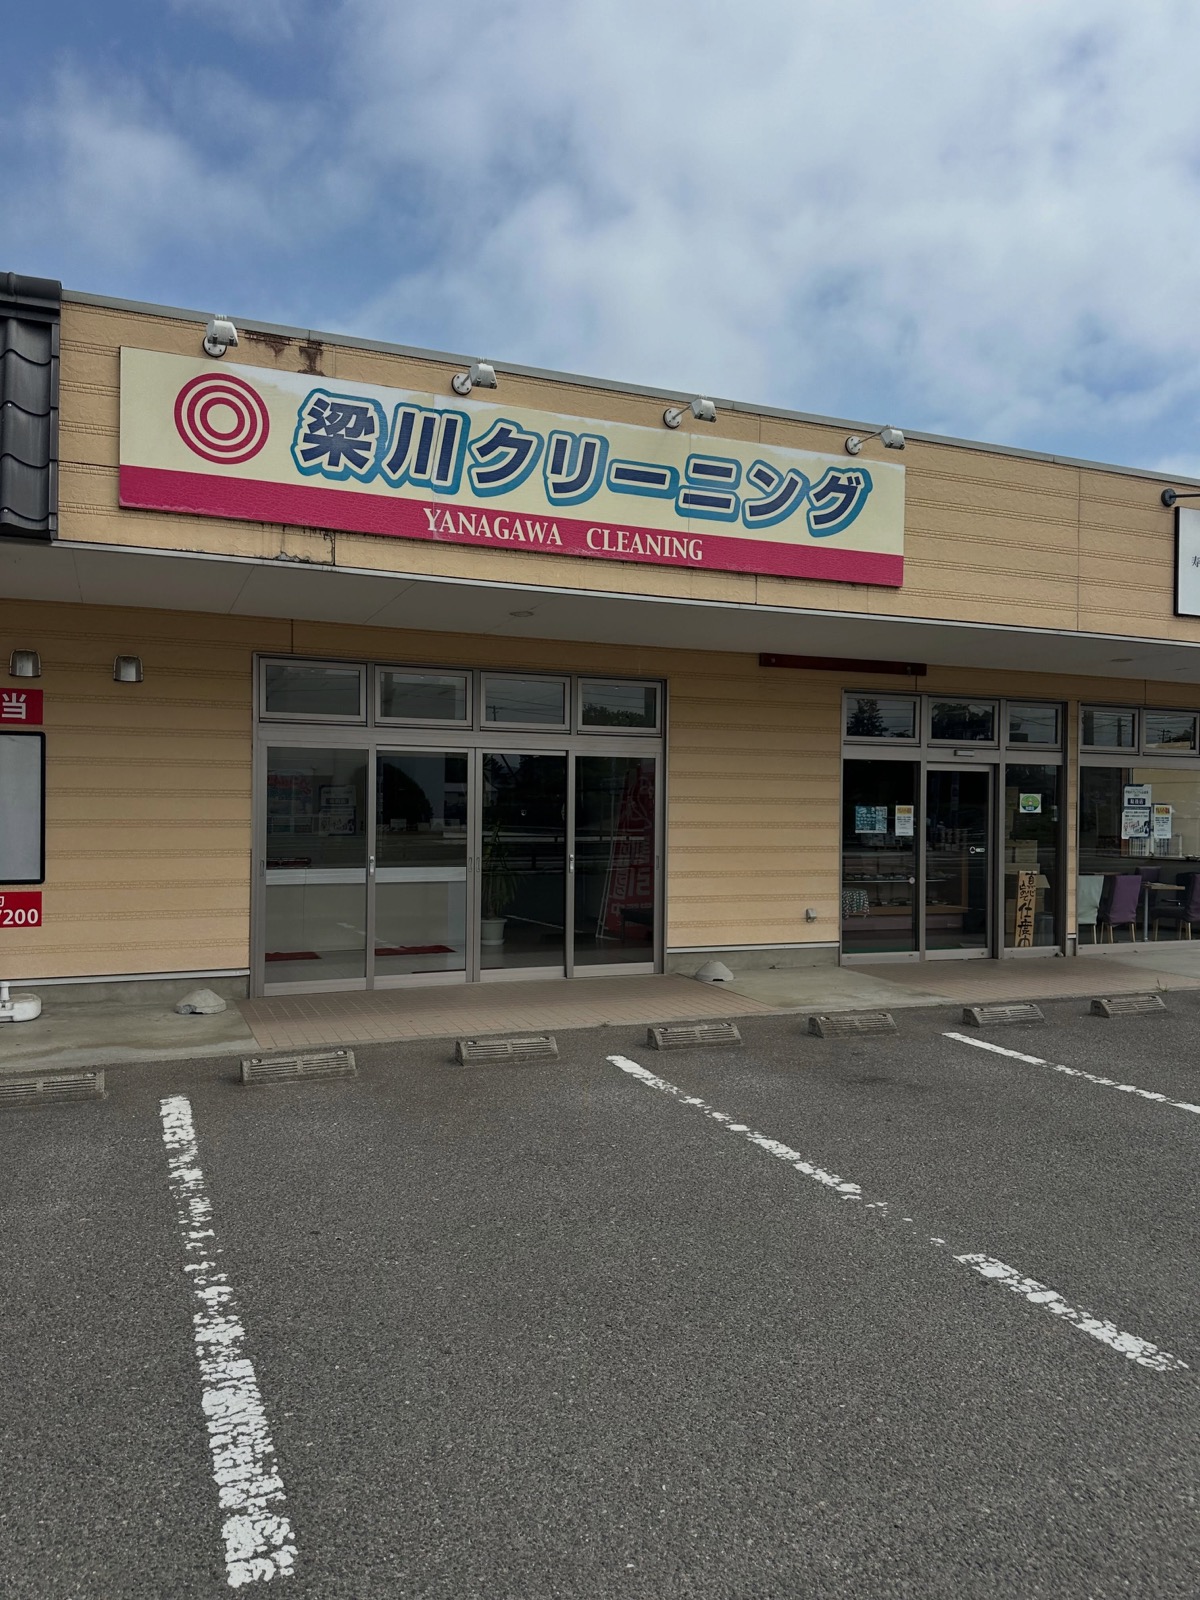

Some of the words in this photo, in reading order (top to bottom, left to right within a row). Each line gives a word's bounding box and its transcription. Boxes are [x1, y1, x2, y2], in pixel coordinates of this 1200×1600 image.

[291, 388, 873, 538] 梁川クリーニング
[423, 508, 563, 546] YANAGAWA
[586, 527, 703, 561] CLEANING
[1, 692, 27, 720] 当
[0, 908, 39, 925] 200
